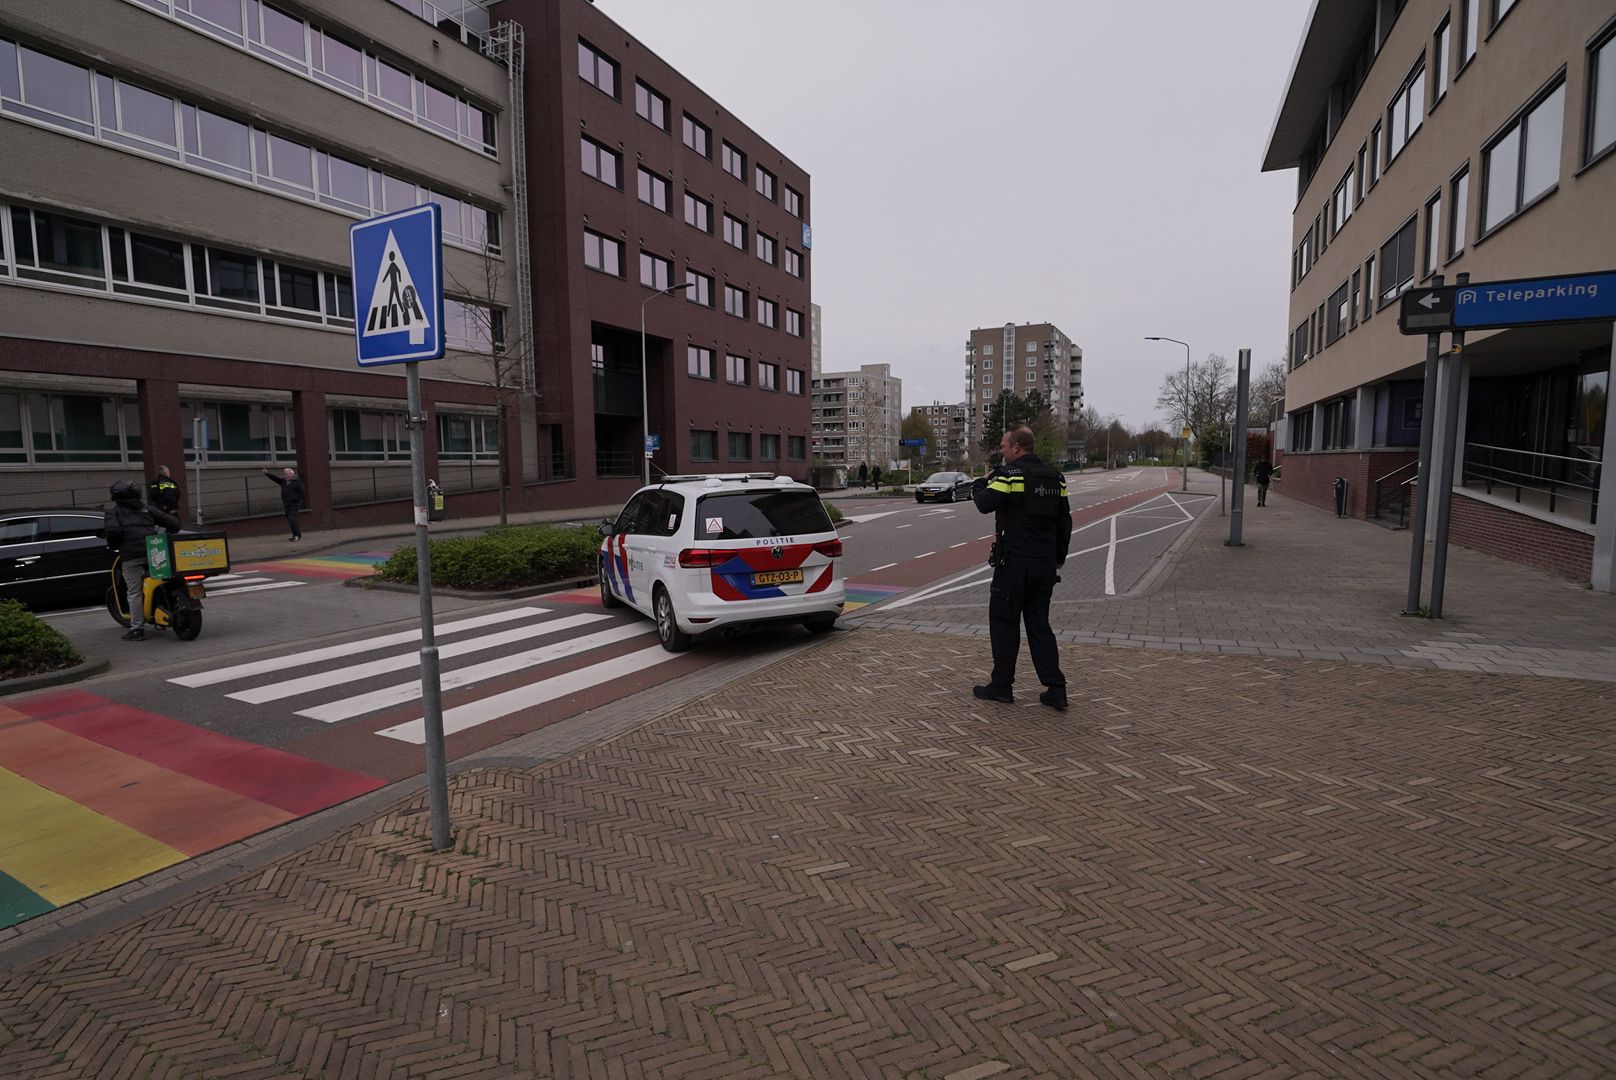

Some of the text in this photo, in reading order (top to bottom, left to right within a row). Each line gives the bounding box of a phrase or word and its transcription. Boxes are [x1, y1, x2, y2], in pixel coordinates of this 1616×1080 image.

[1486, 284, 1598, 302] Teleparking
[756, 537, 795, 545] POLITIE
[759, 571, 798, 582] GTZ-03-P
